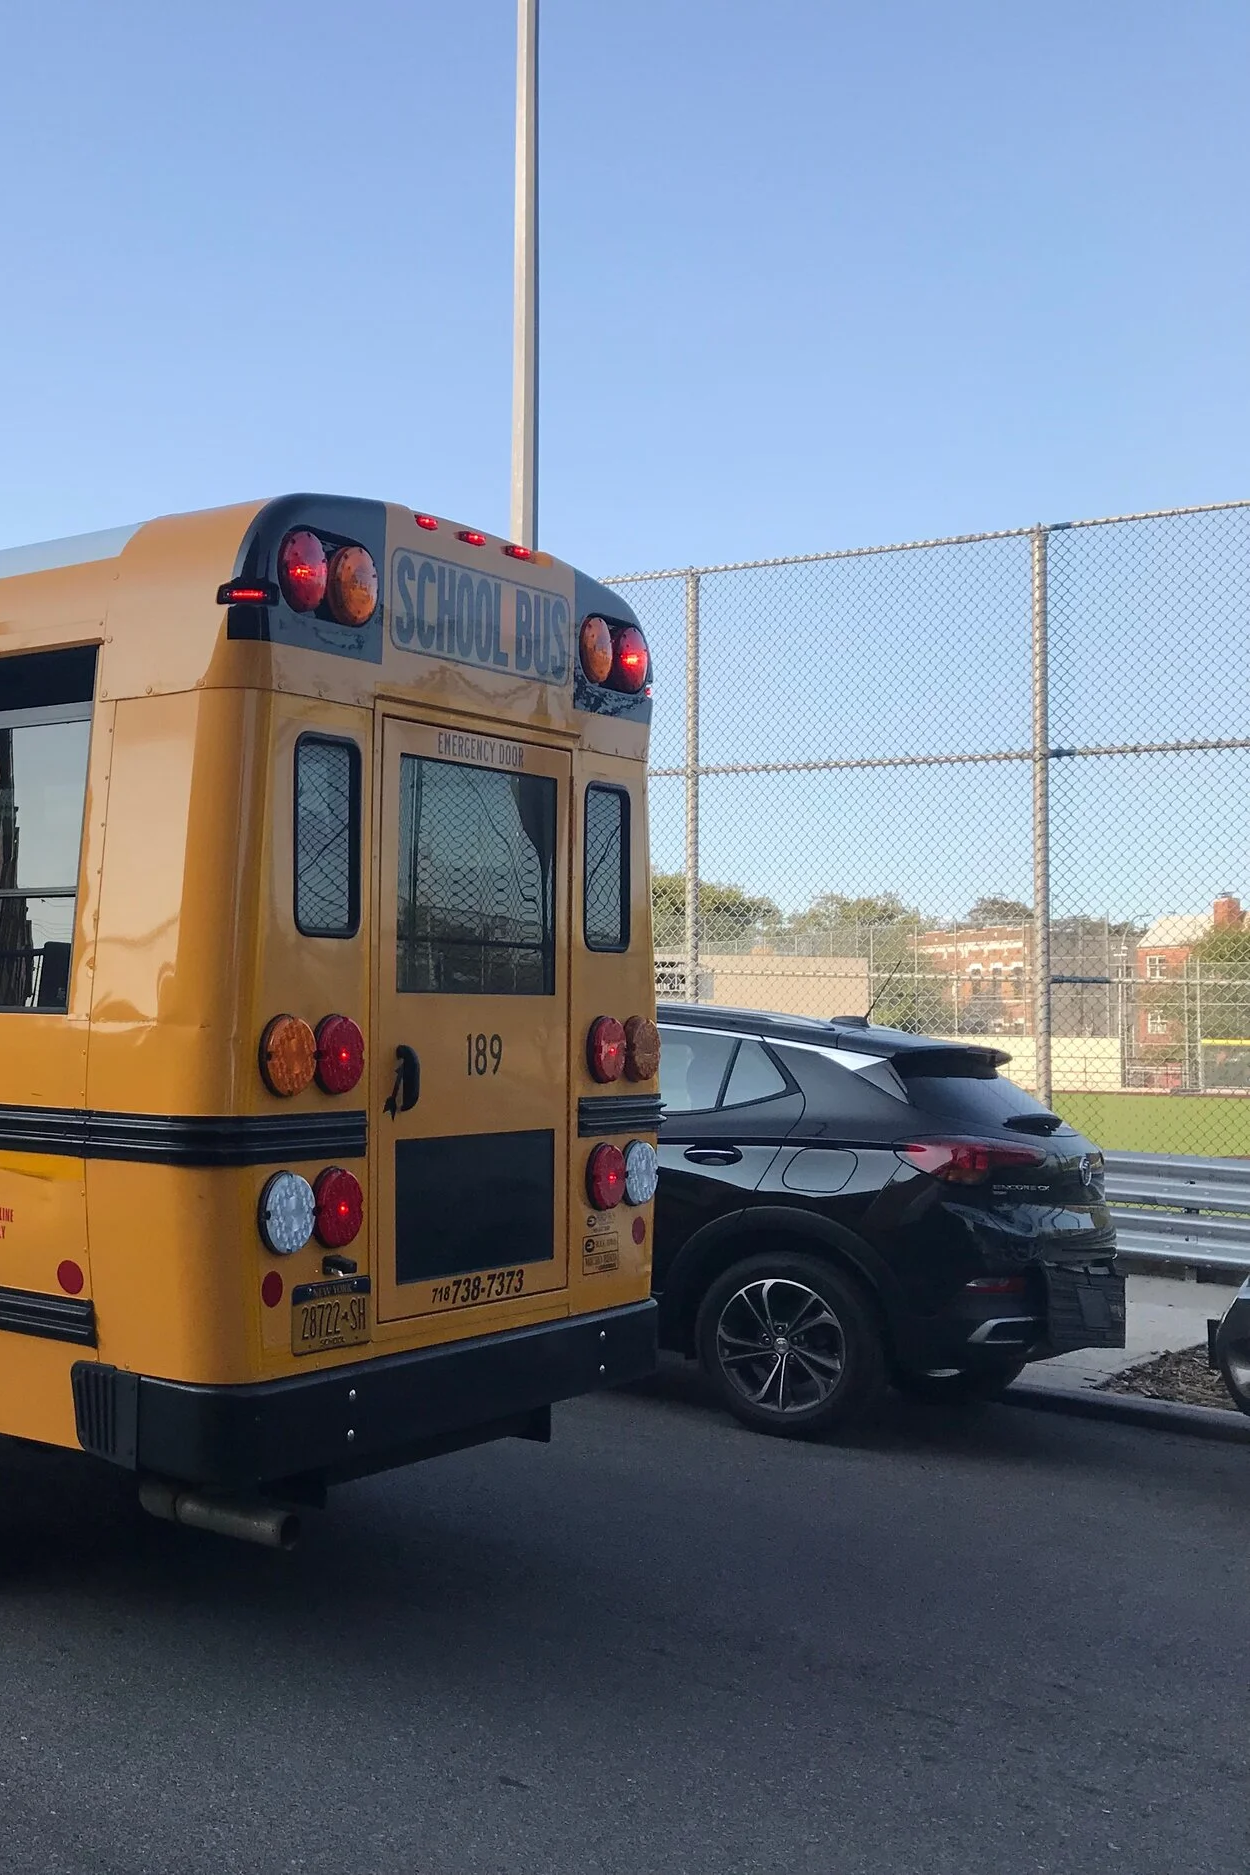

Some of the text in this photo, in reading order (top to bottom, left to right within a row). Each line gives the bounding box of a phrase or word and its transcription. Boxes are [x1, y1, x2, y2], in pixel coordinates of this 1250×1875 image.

[395, 554, 567, 680] SCHOOL BUS
[437, 731, 524, 769] EMERGENCY DOOR
[466, 1033, 503, 1076] 189
[313, 1283, 352, 1298] NEW YORK
[431, 1268, 525, 1305] 718 738-7373
